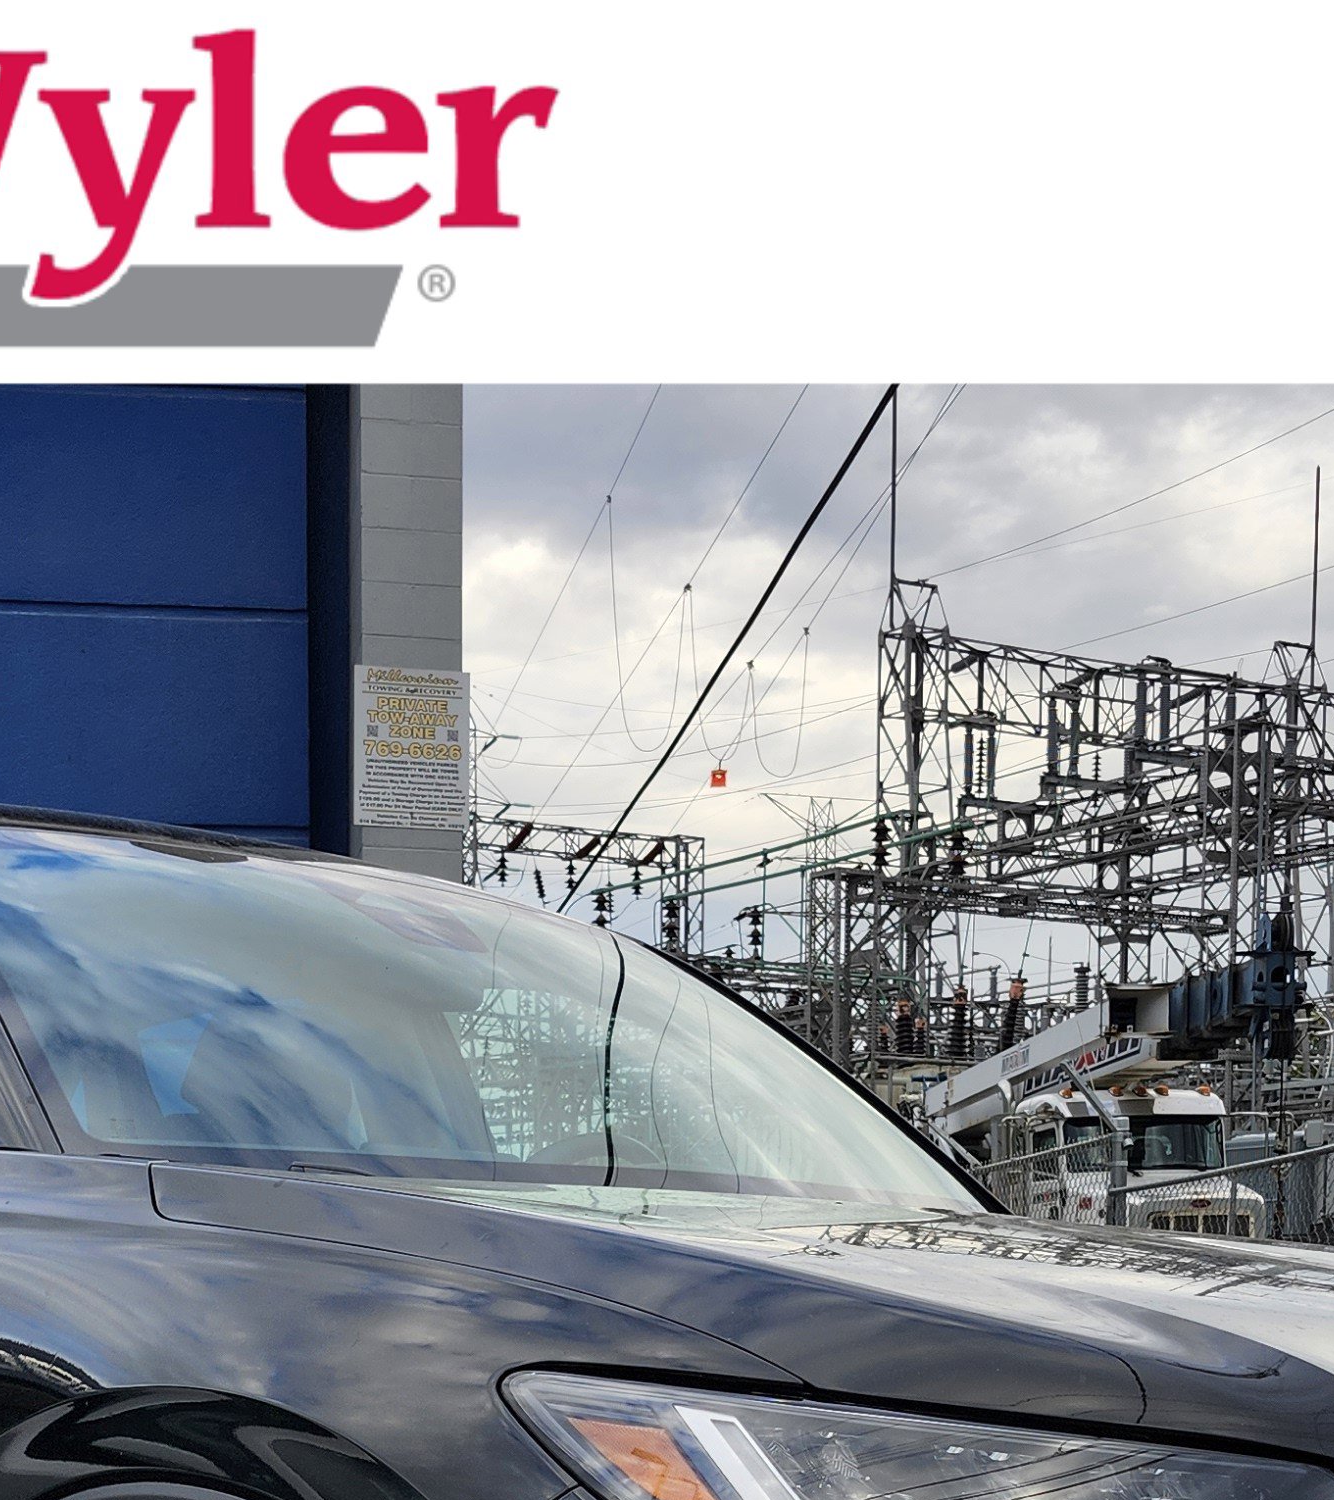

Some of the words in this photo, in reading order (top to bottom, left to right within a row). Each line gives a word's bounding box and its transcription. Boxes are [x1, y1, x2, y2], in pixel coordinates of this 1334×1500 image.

[368, 684, 402, 692] TOWING
[377, 696, 447, 713] PRIVATE
[367, 709, 458, 727] TOW-AWAY
[389, 724, 435, 739] ZONE
[363, 739, 461, 761] 769-6626
